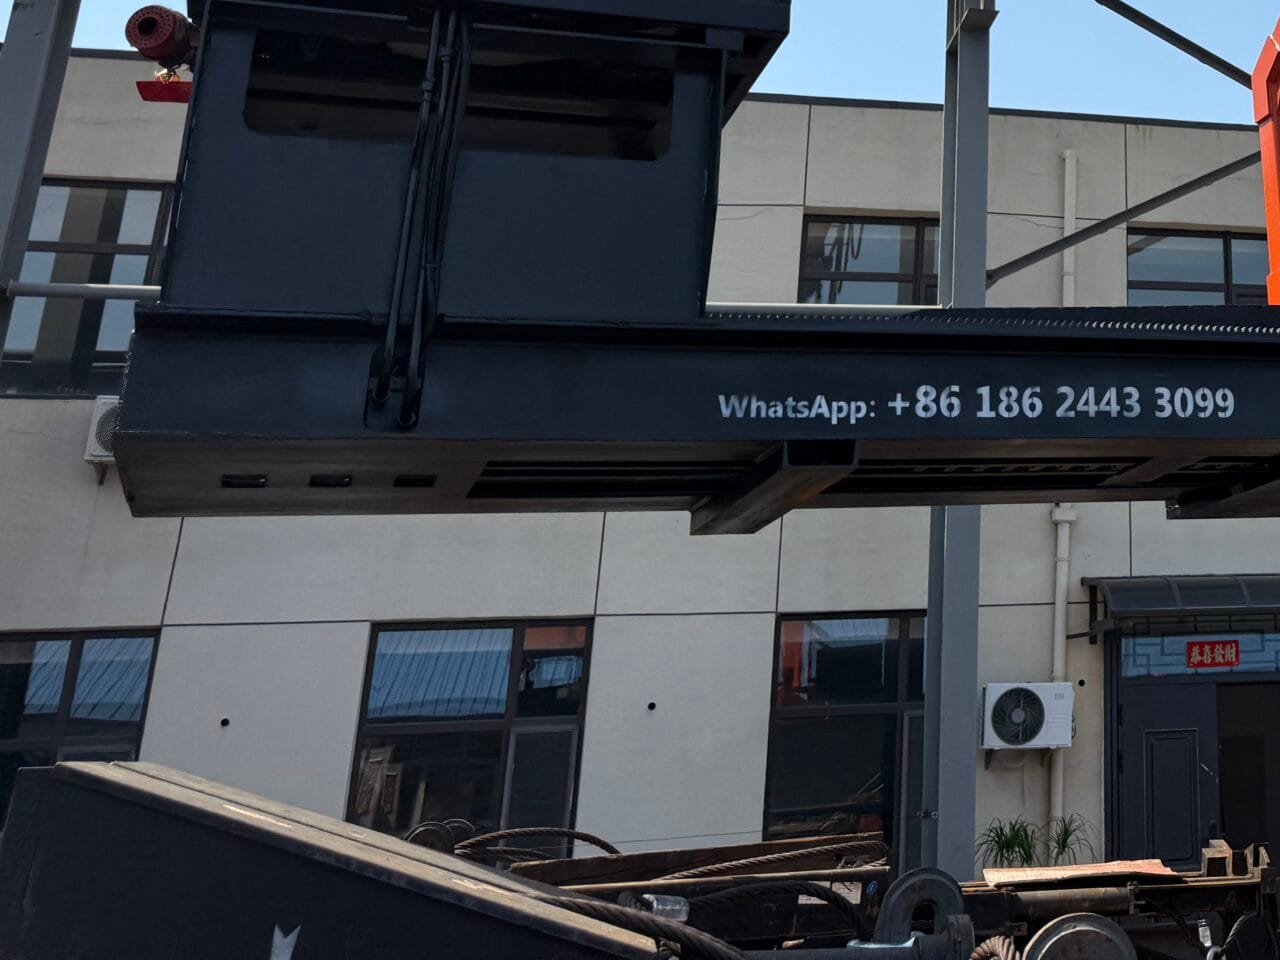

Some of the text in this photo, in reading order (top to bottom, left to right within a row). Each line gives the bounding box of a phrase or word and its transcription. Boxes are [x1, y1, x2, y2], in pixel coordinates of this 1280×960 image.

[718, 384, 1236, 425] WhatsApp: +86 186 2443 3099
